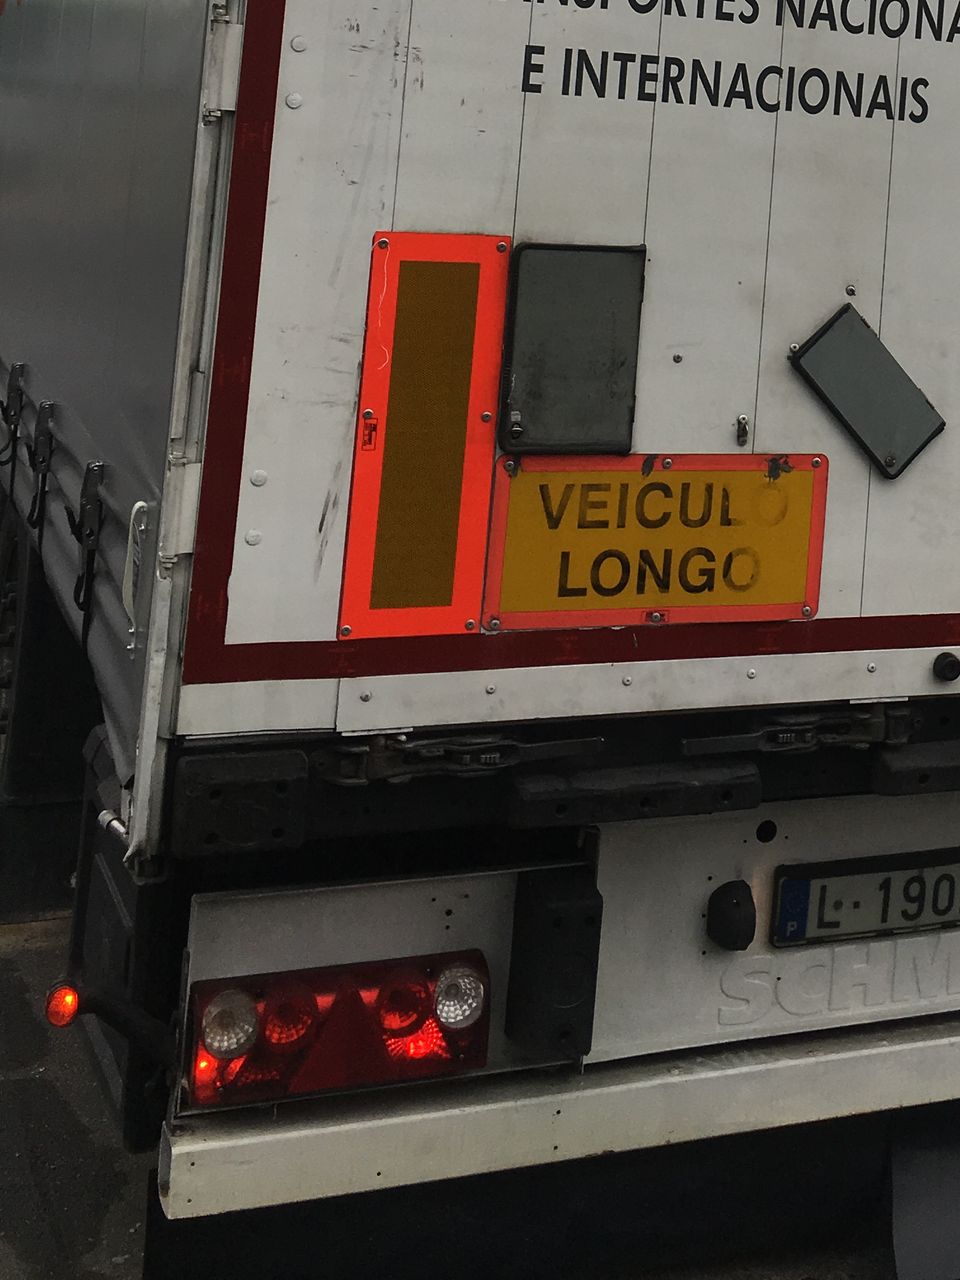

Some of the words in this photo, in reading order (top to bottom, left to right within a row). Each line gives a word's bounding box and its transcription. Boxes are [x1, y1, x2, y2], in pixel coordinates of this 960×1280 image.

[521, 44, 546, 94] E
[560, 47, 931, 124] INTERNACIONAIS
[557, 546, 761, 598] LONGO
